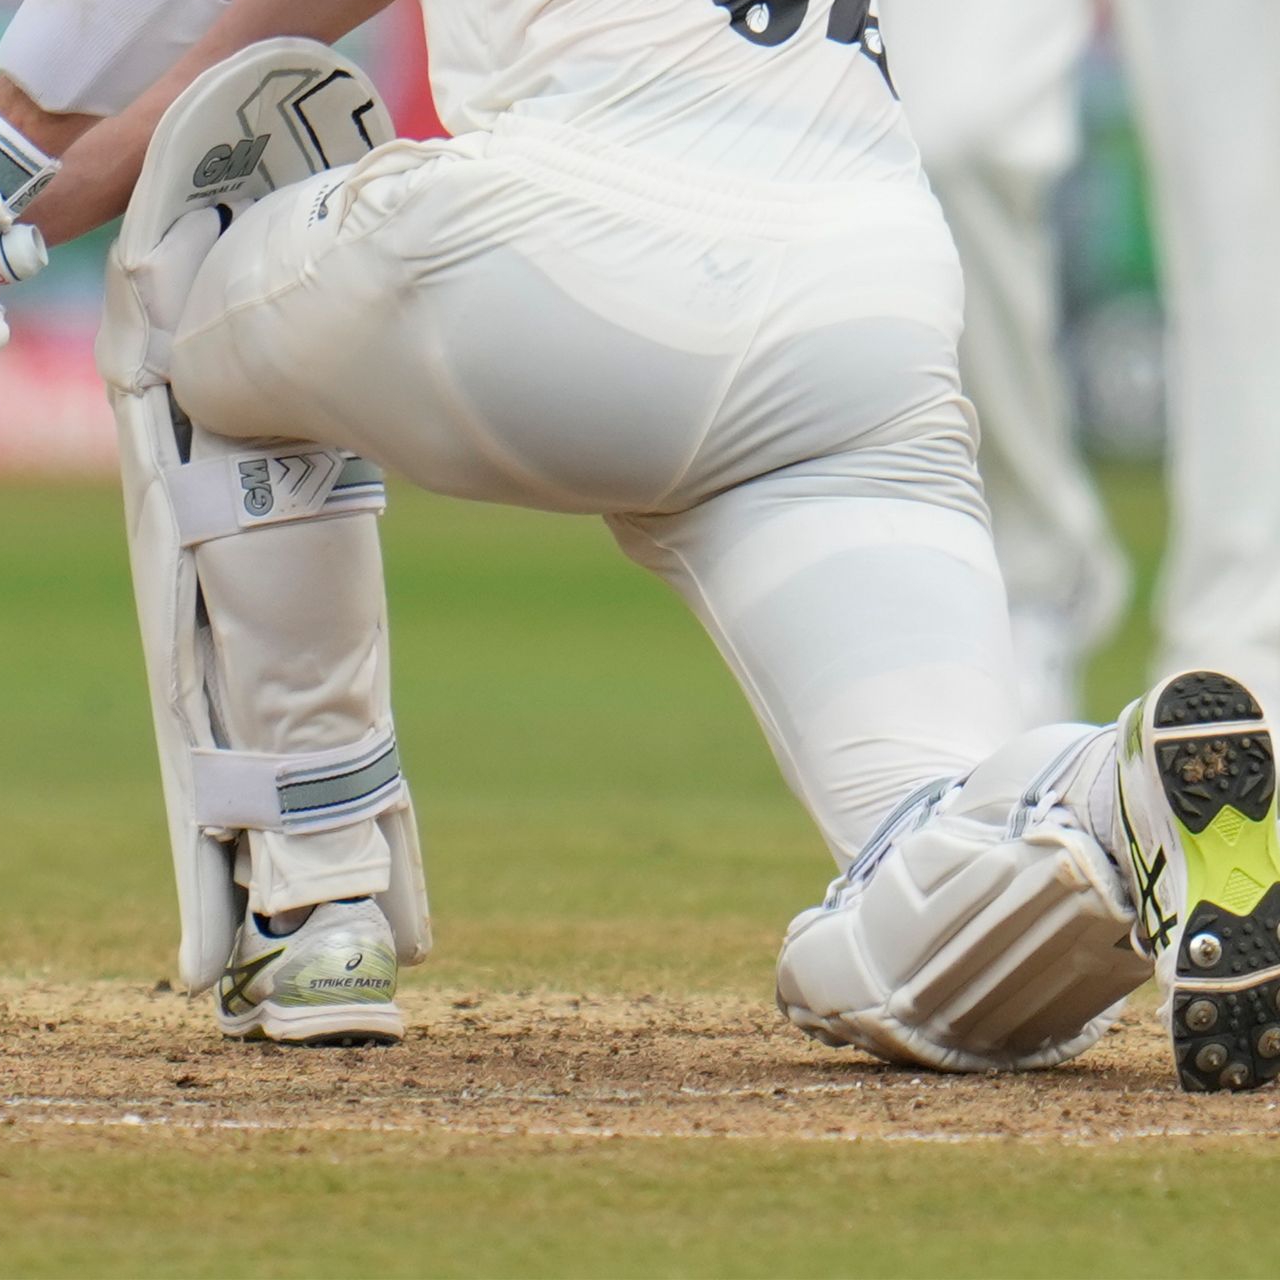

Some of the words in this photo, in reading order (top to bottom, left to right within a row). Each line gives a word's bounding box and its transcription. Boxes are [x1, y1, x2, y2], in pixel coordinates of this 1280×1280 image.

[193, 133, 272, 189] GM
[239, 459, 274, 517] GM
[310, 978, 352, 989] STRIKE
